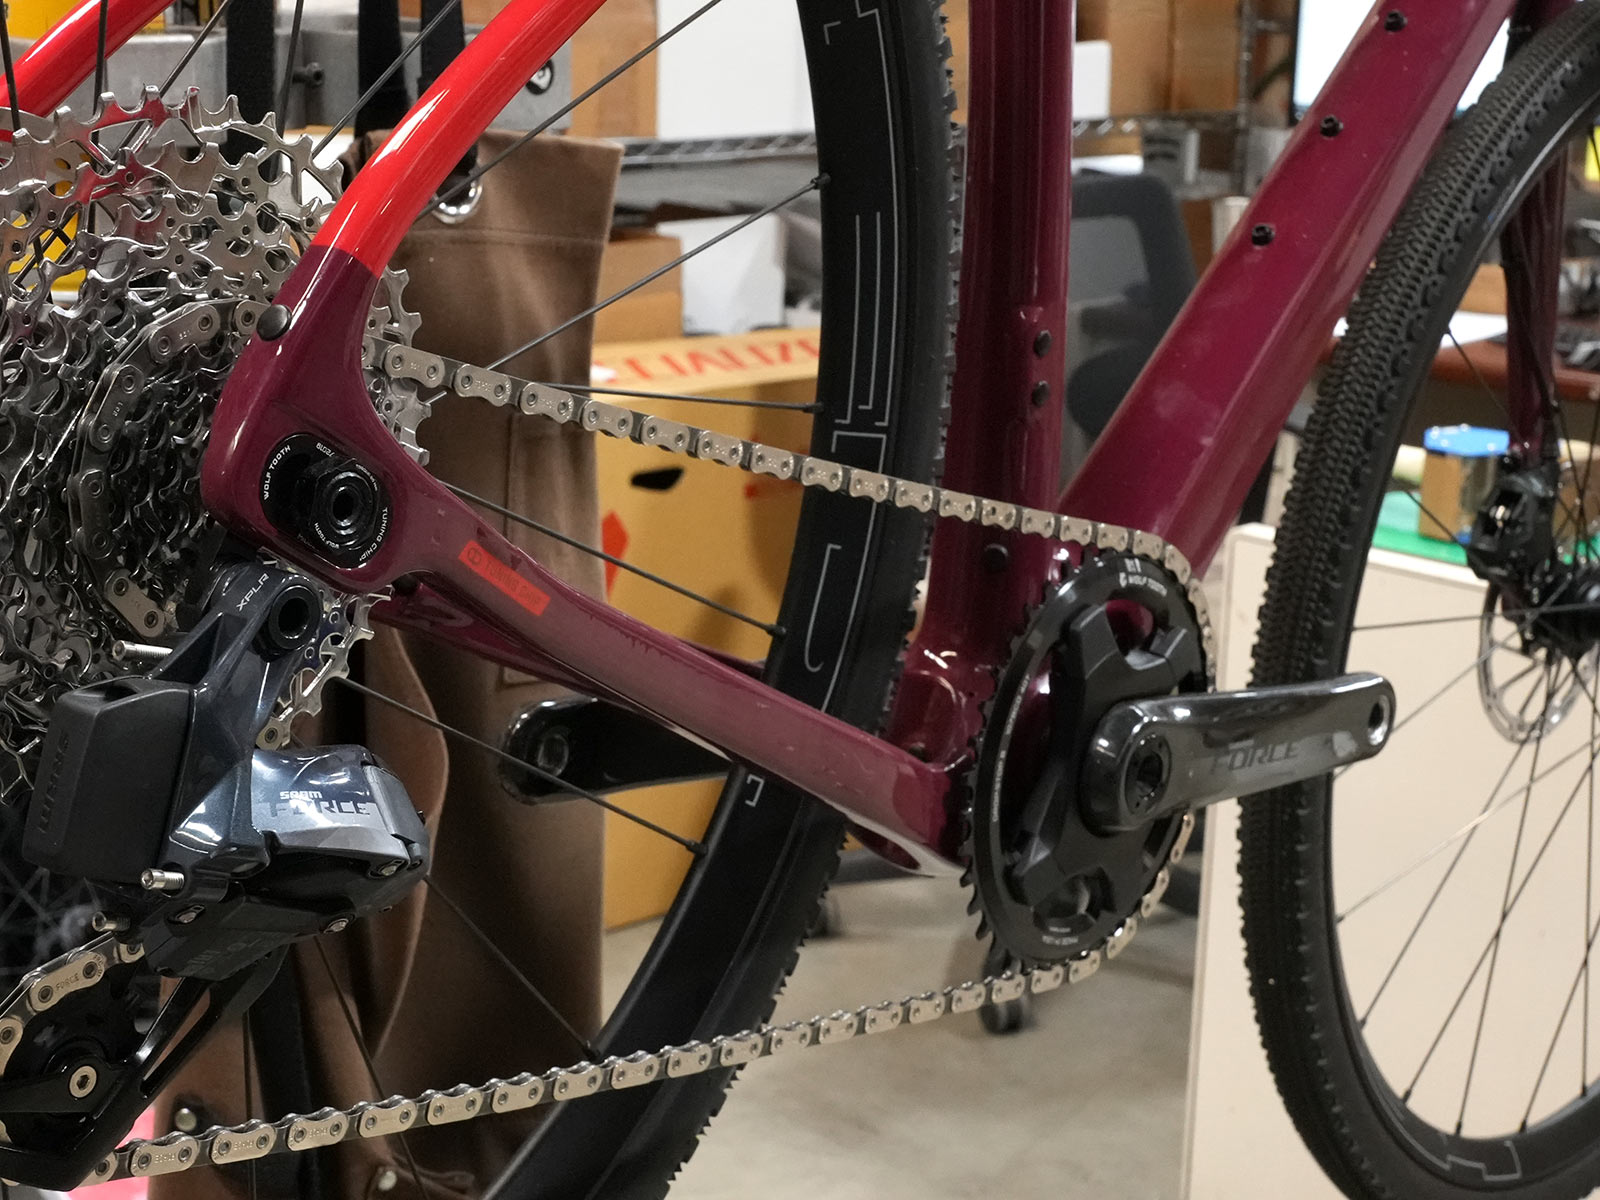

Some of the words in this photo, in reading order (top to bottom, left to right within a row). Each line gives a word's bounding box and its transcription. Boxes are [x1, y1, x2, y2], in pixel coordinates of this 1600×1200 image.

[263, 471, 271, 500] WOLF
[268, 444, 292, 471] TOOTH
[376, 507, 389, 542] TUNING
[359, 542, 378, 561] CHIP
[235, 573, 270, 612] XPLR
[1208, 742, 1301, 776] FORCE
[268, 799, 376, 818] FORCE
[55, 972, 81, 992] FORCE
